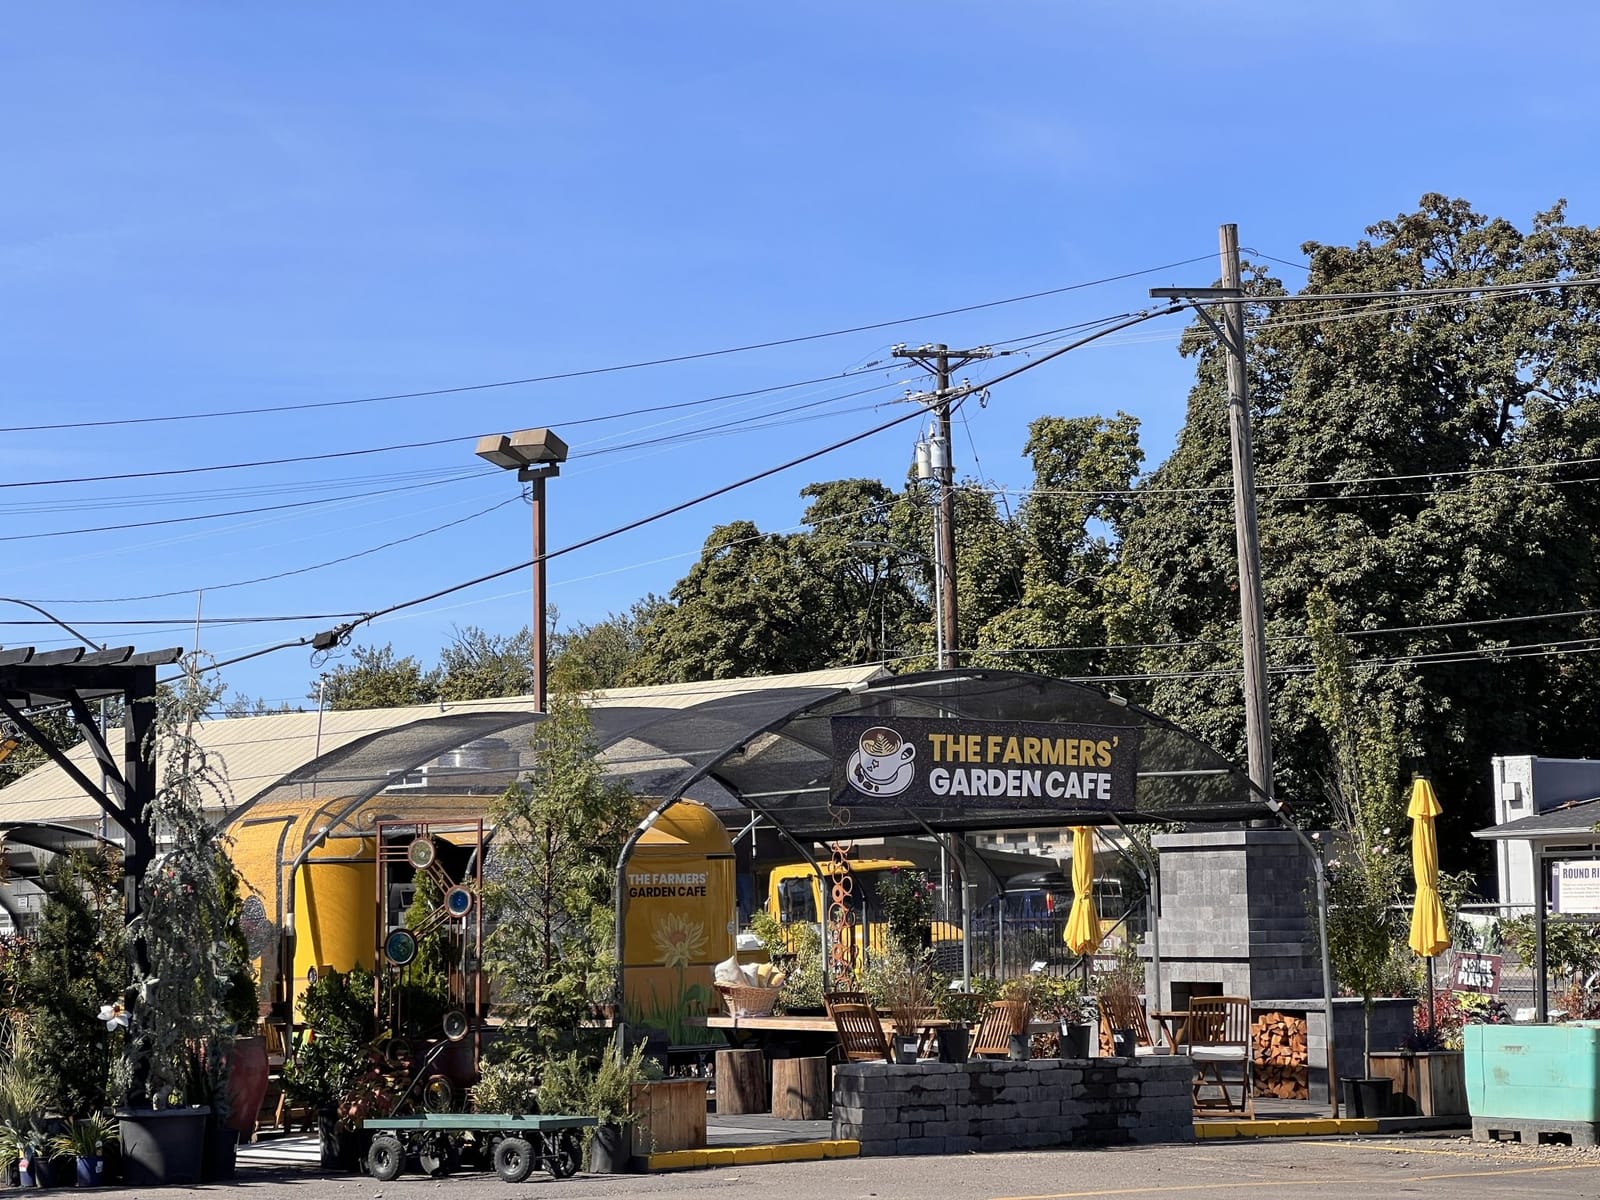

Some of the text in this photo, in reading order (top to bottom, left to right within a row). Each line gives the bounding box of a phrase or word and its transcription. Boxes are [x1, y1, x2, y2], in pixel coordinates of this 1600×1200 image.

[928, 733, 1119, 767] THE FARMERS'
[929, 767, 1111, 800] GARDEN CAFE
[628, 873, 650, 885] THE
[1563, 868, 1590, 879] ROUND
[629, 886, 707, 898] GARDEN CAFE
